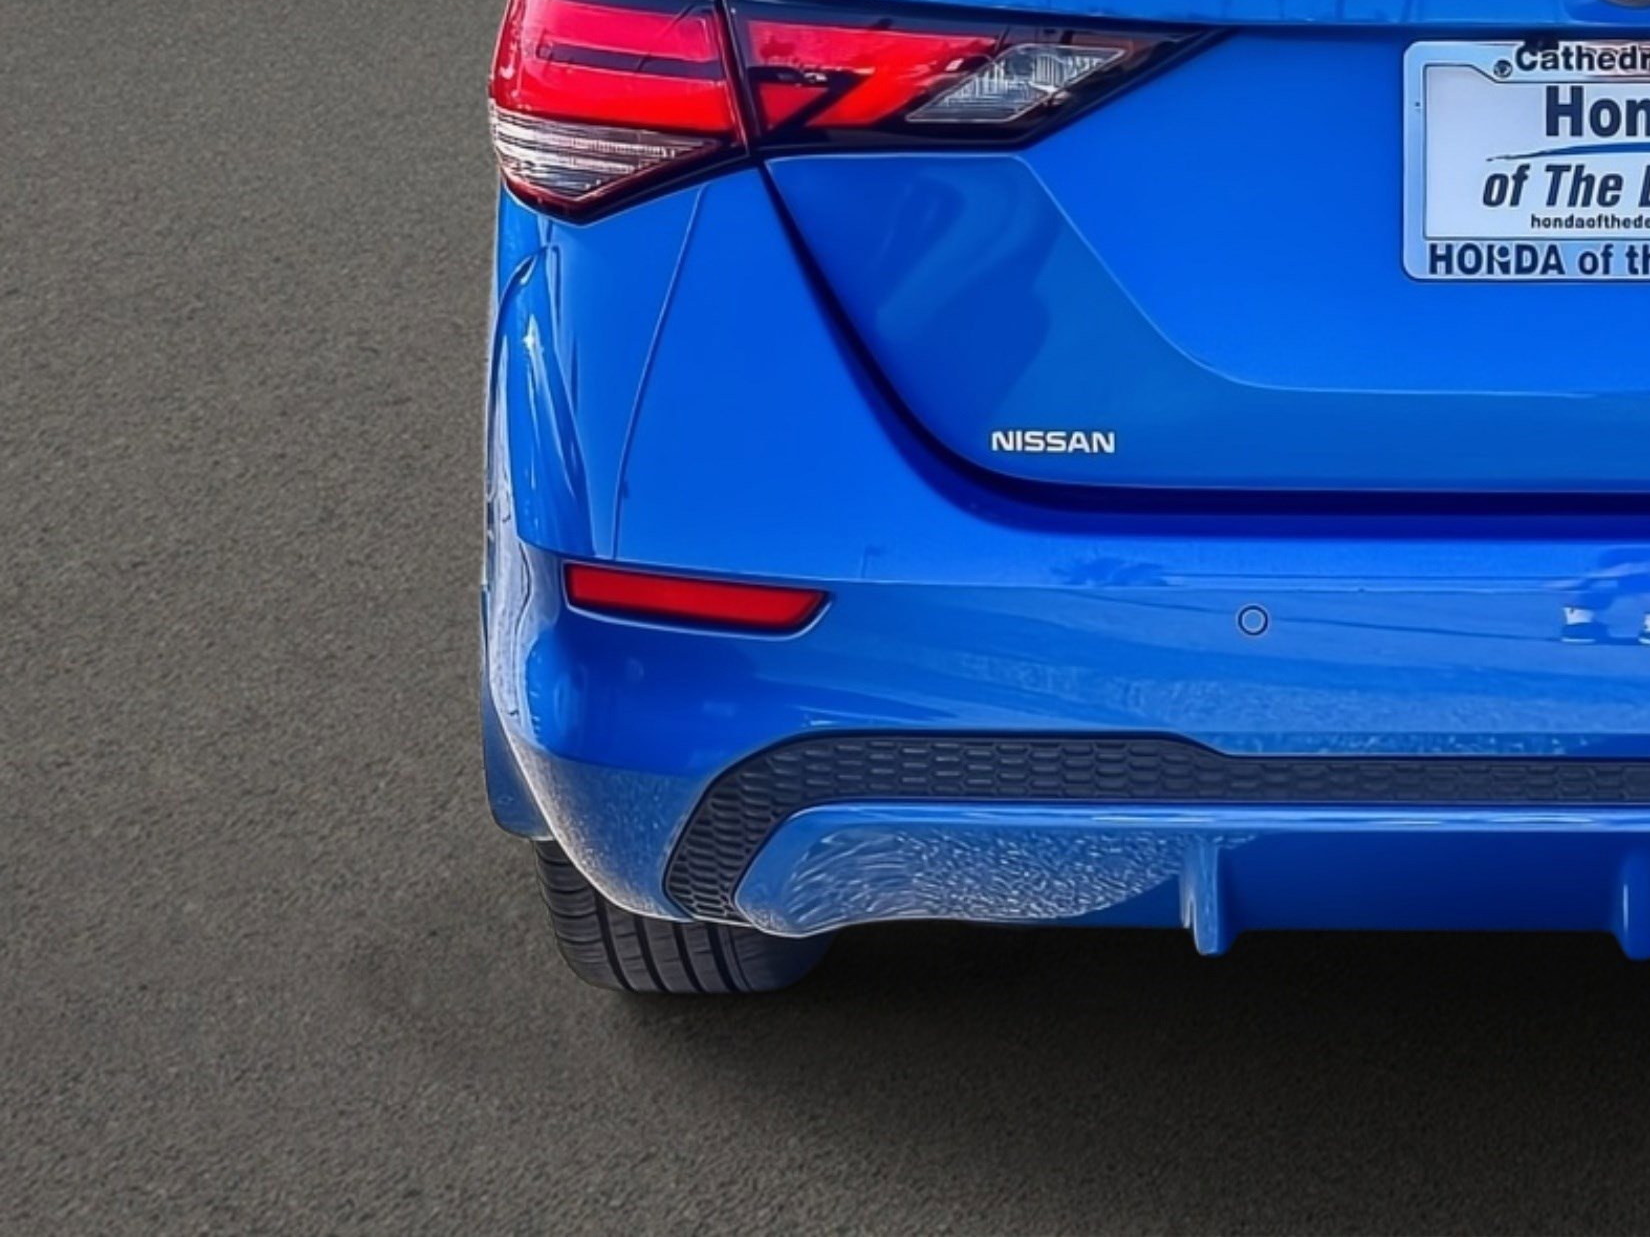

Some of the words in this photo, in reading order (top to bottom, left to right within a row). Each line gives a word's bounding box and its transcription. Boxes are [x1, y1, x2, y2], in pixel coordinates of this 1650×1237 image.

[1482, 163, 1531, 208] of
[1544, 163, 1624, 208] The
[1428, 242, 1566, 276] HONDA
[1577, 243, 1615, 276] of
[991, 430, 1116, 454] NISSAN
